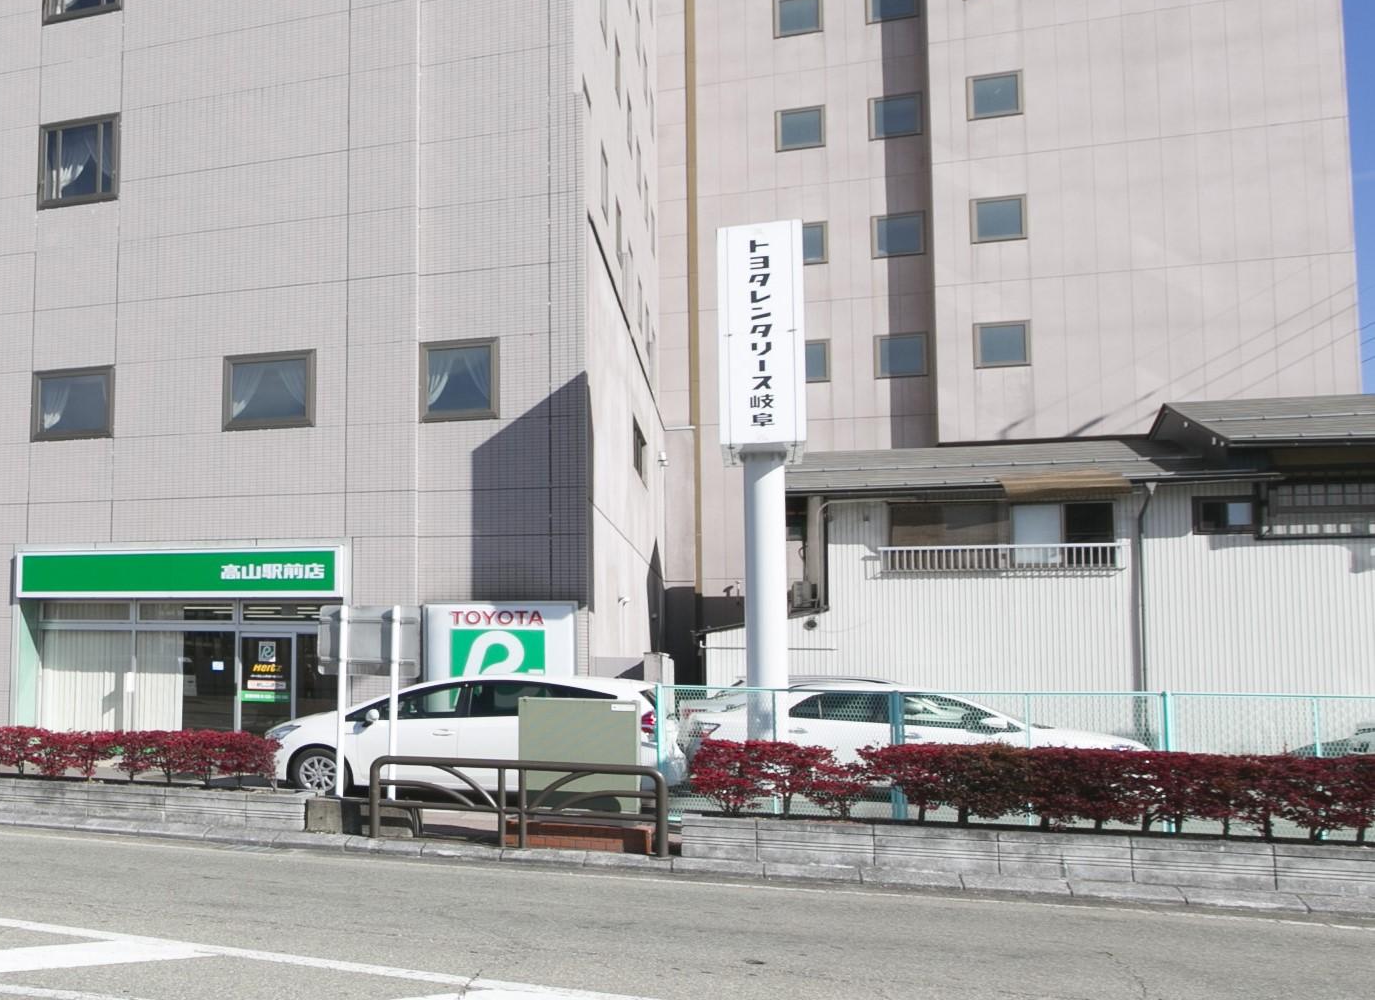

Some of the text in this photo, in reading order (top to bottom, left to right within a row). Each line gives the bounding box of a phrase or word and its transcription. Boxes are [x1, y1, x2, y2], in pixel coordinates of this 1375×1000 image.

[748, 239, 775, 427] トヨタレンタリース岐阜
[220, 563, 326, 580] 高山駅前店
[450, 610, 544, 626] TOYOTA
